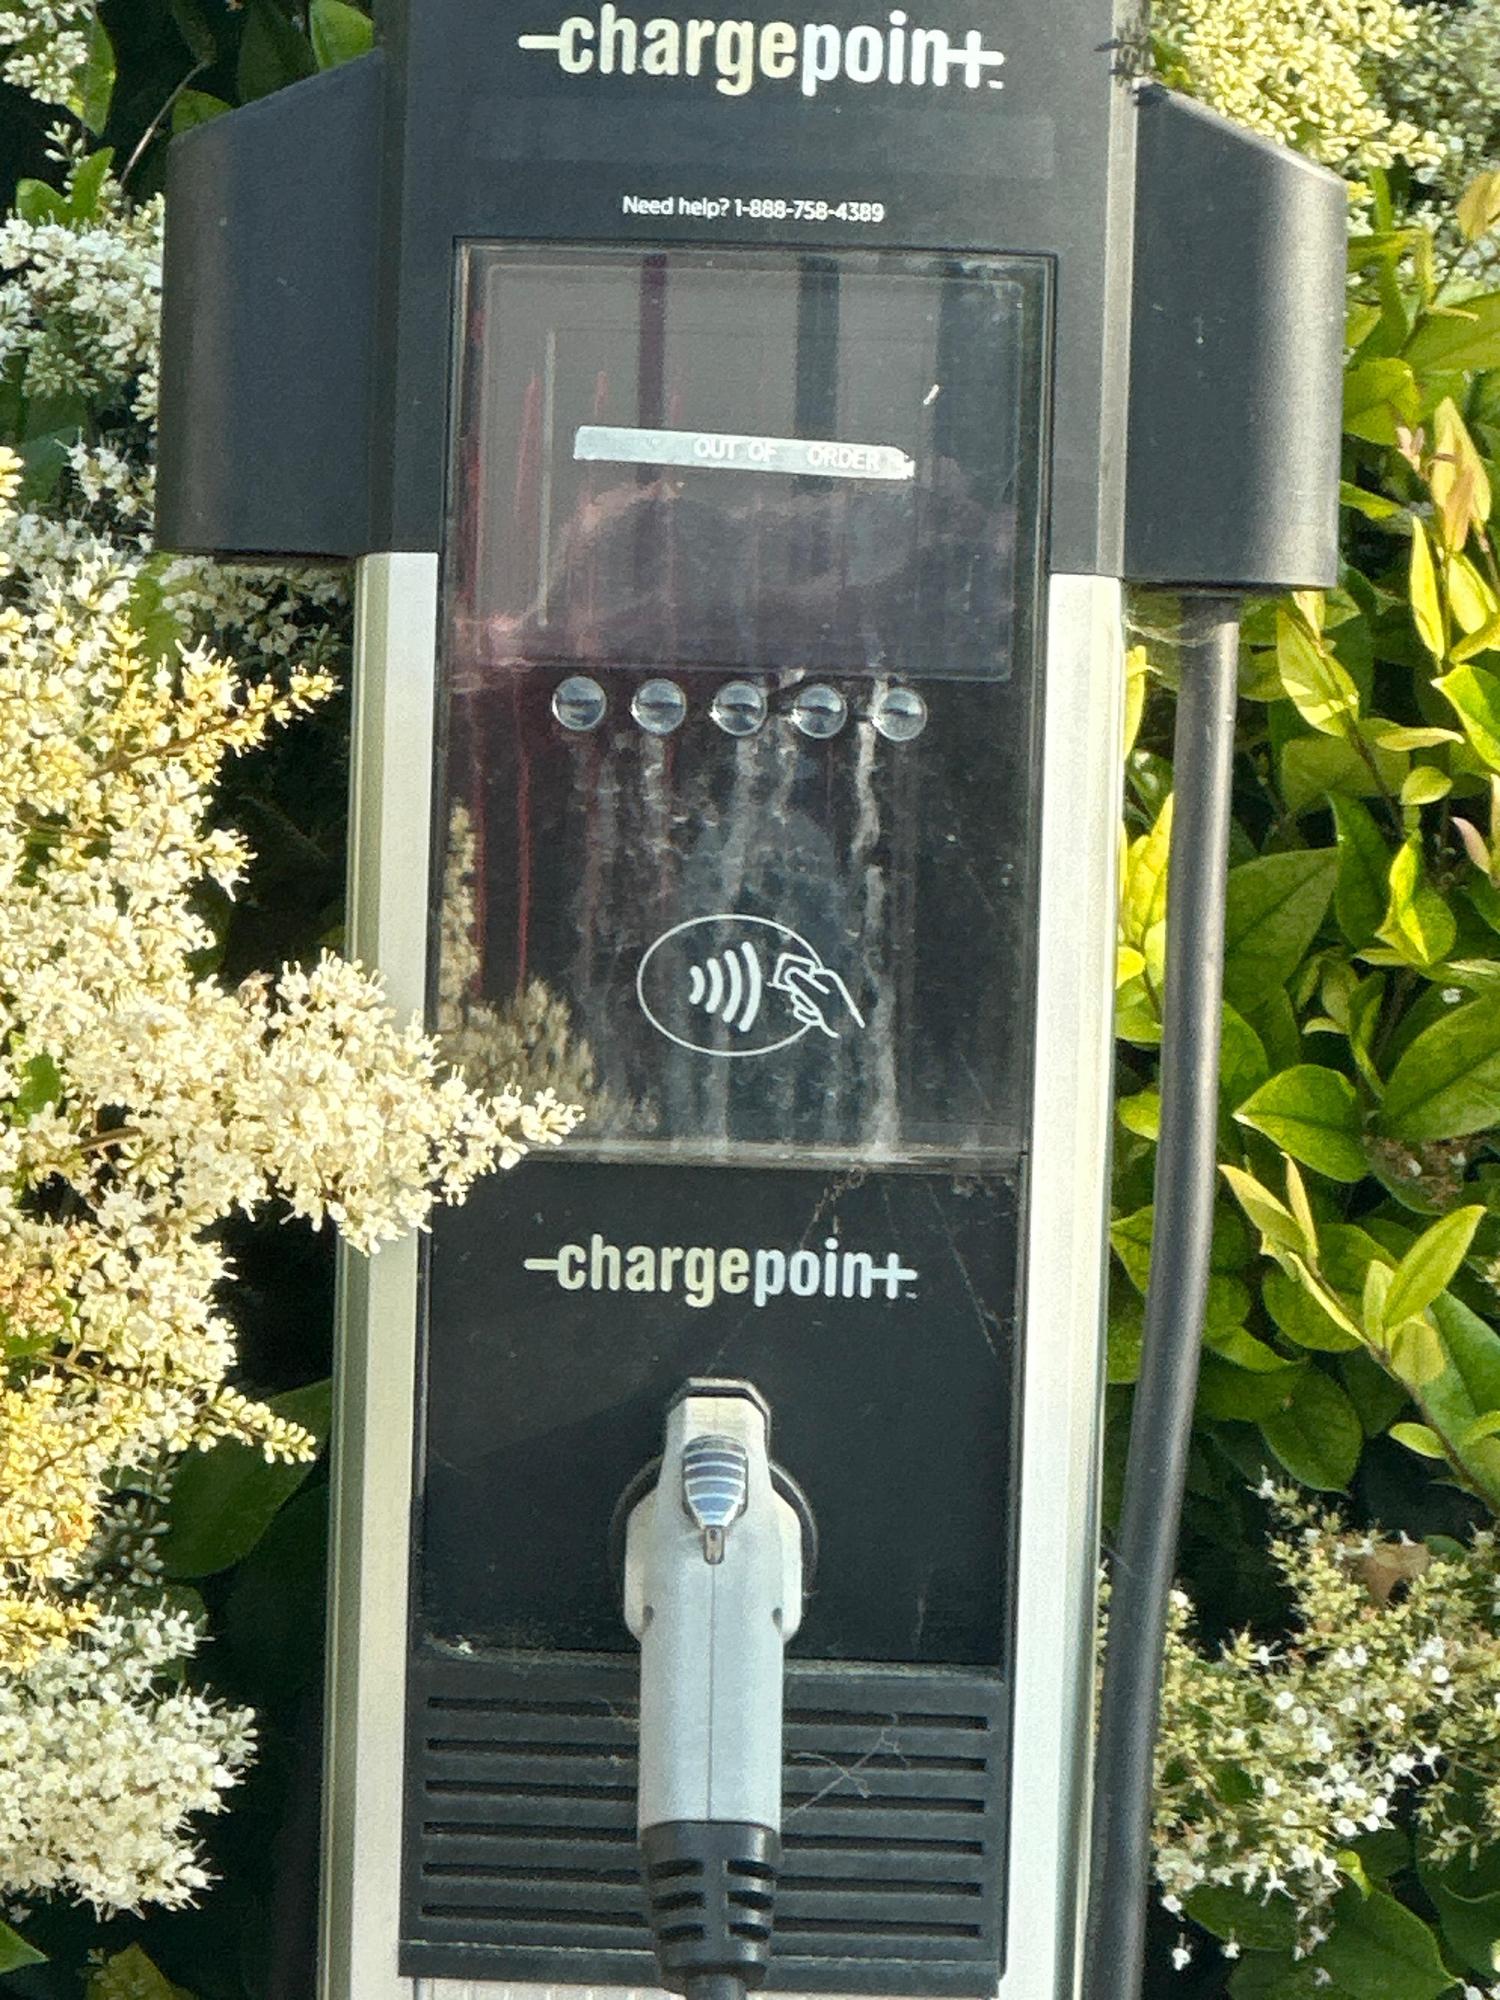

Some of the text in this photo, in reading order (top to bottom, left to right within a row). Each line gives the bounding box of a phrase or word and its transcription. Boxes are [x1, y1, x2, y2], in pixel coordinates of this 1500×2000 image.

[518, 3, 1005, 96] chargepoint
[622, 195, 885, 222] Need help? 1-888-758-4389
[694, 438, 881, 473] OUT OF ORDER
[524, 1233, 919, 1308] chargepoint
